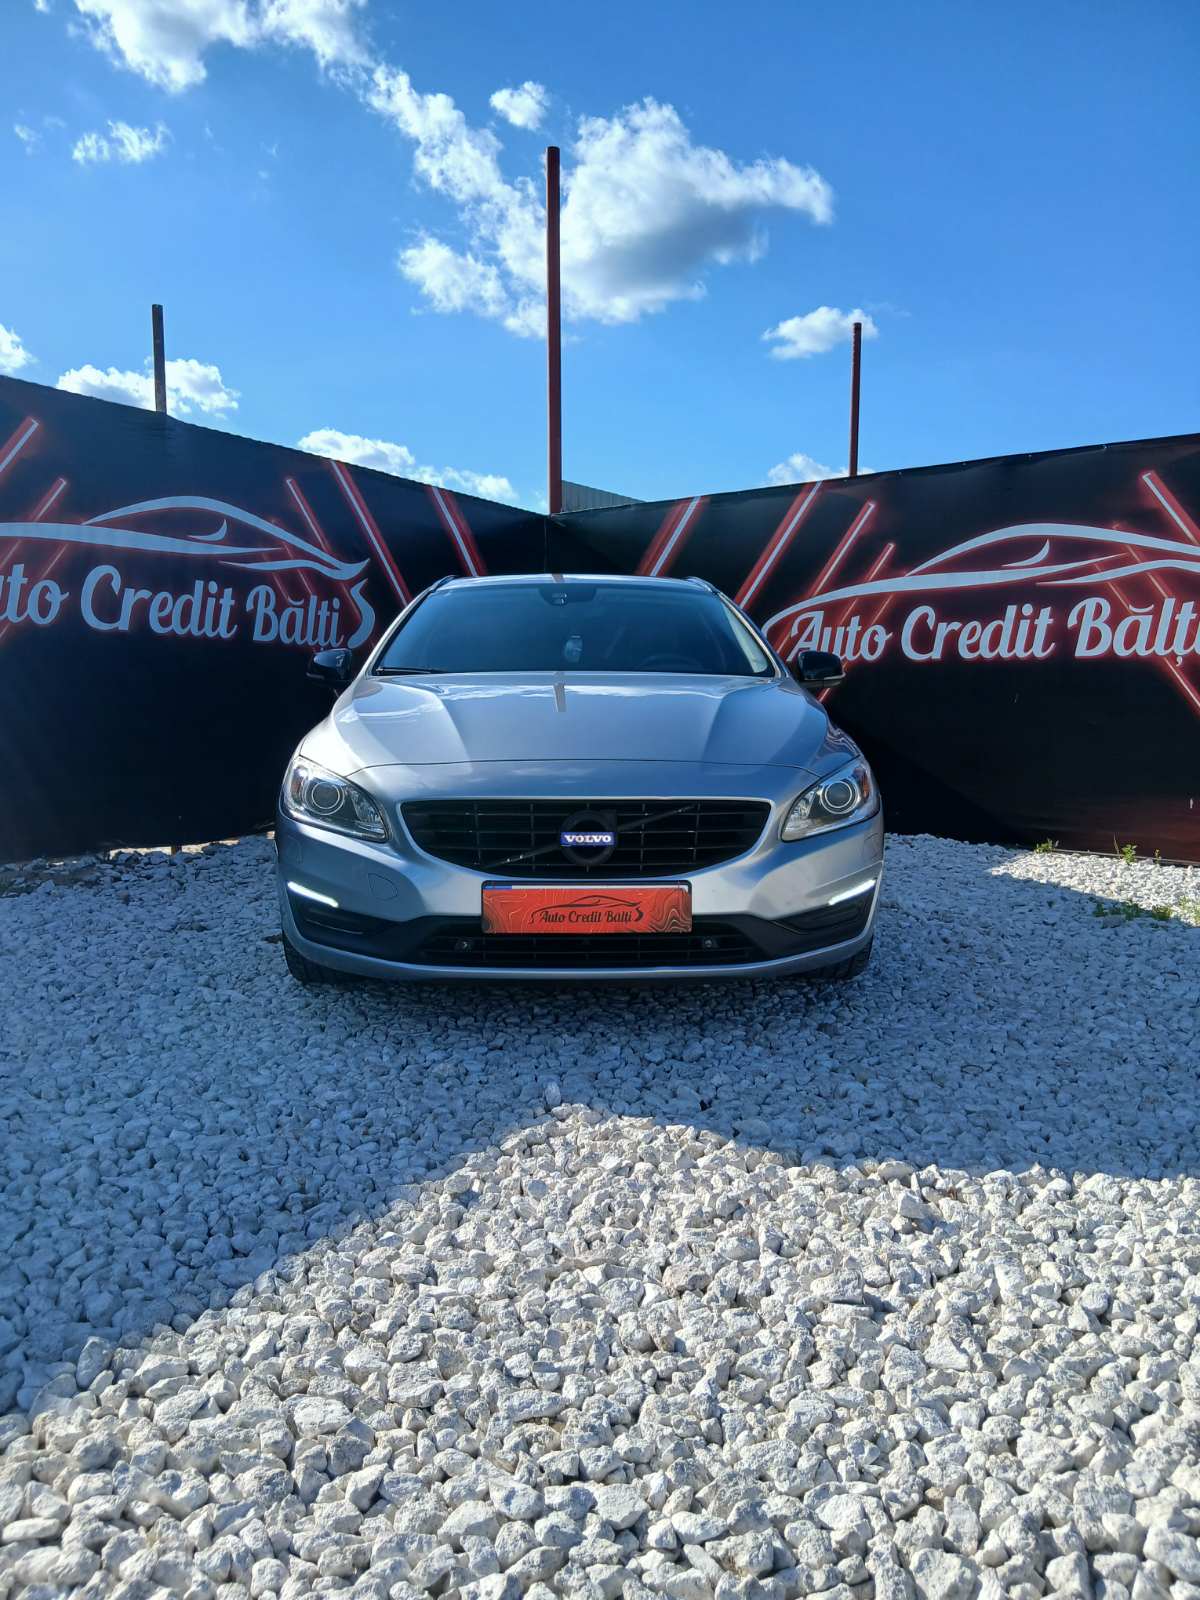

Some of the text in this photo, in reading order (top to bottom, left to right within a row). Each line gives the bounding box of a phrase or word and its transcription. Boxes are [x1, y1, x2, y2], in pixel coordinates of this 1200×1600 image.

[81, 565, 238, 639] Credit
[787, 610, 893, 661] Auto
[901, 604, 1055, 661] Credit
[564, 834, 612, 843] VOLVO
[540, 910, 566, 923] Auto
[565, 910, 601, 923] Credit
